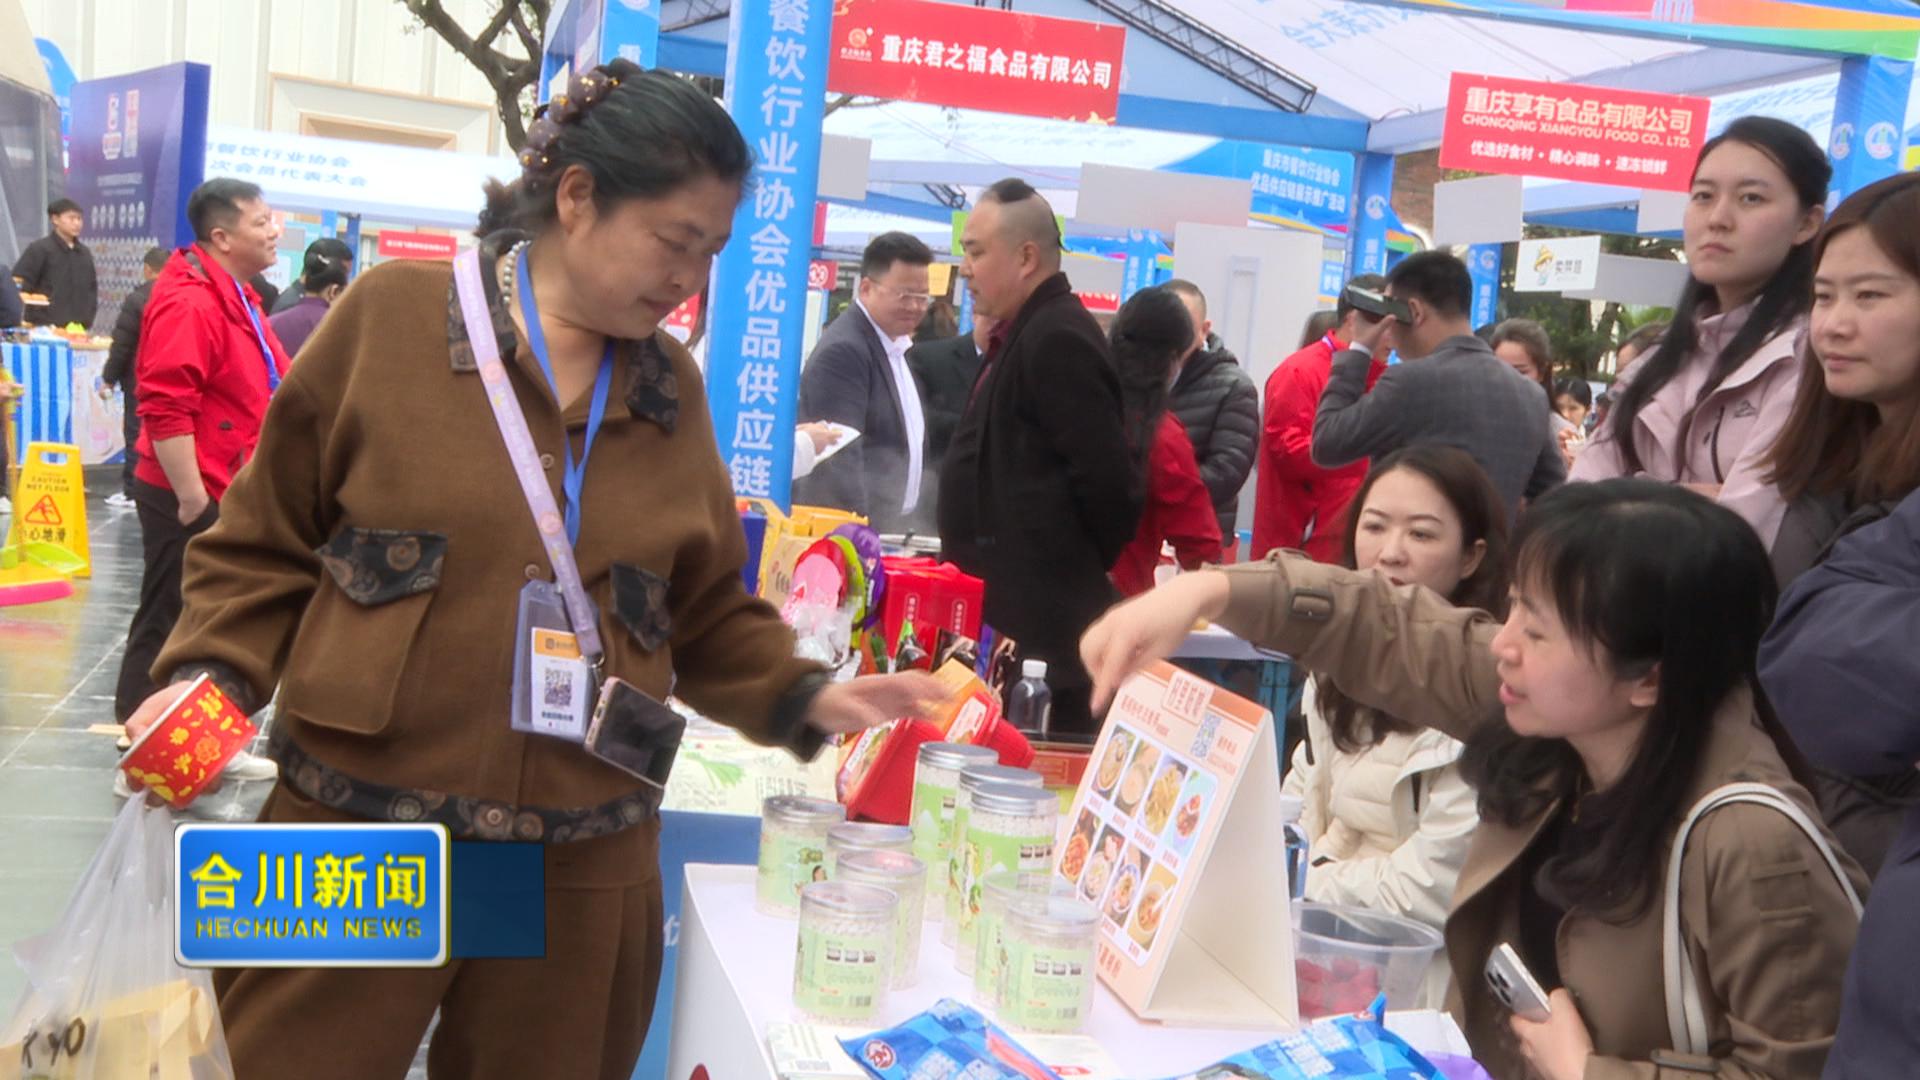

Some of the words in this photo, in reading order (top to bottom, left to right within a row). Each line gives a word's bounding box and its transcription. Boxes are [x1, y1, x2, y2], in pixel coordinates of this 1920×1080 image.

[881, 35, 1113, 89] 重庆君之福食品有限公司
[1462, 114, 1537, 132] CHONGQING
[1539, 122, 1602, 140] XIANGYOU
[1605, 129, 1639, 144] FOOD
[1667, 136, 1692, 149] LTD.
[1464, 86, 1693, 135] 重庆享有食品有限公司
[1470, 140, 1535, 161] 优选好食材
[728, 0, 811, 496] 餐饮行业协会优品供应链
[22, 527, 67, 542] 心地滑
